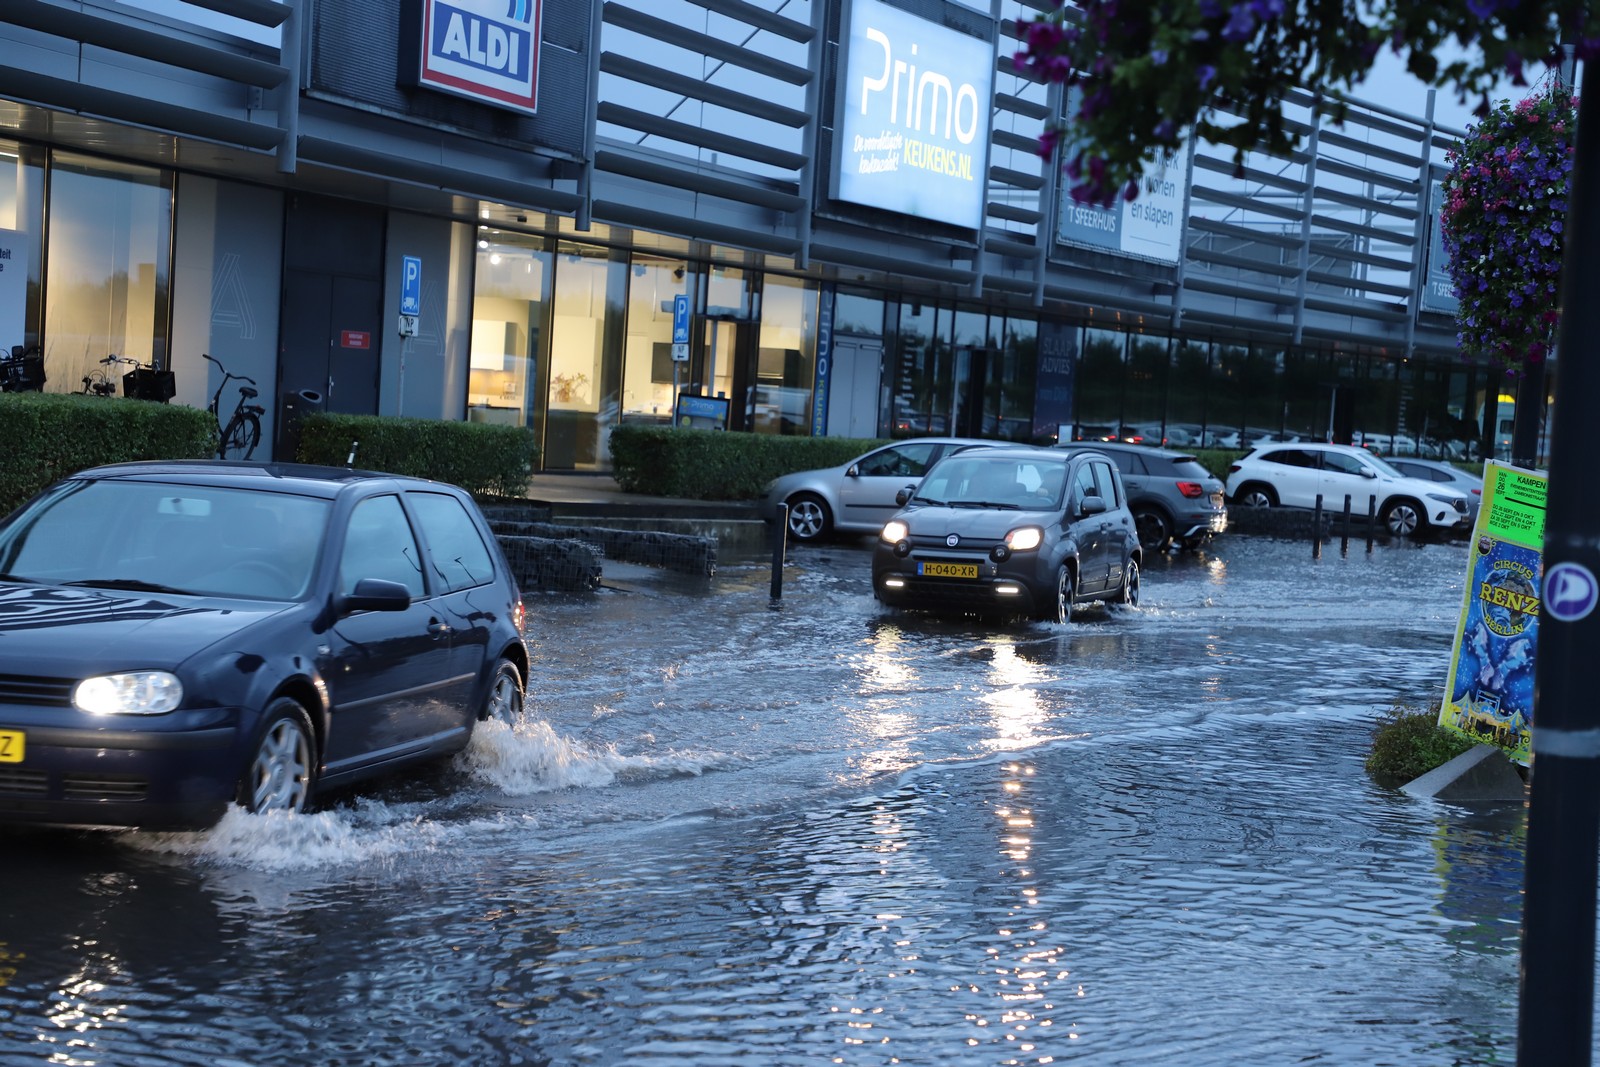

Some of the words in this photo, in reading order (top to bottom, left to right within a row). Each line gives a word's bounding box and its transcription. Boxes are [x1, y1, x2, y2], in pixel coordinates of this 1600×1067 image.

[441, 12, 519, 75] ALDI
[861, 27, 978, 145] Primo
[903, 138, 973, 181] KEUKENS.NL
[1075, 208, 1116, 233] SFEERHUIS
[1131, 202, 1142, 219] en
[1144, 201, 1174, 228] slapen
[406, 262, 417, 290] P
[677, 299, 686, 323] P
[1041, 358, 1071, 375] ADVIES
[1497, 482, 1505, 491] 26
[1517, 476, 1546, 489] KAMPEN
[925, 565, 975, 577] H-040-XR
[1493, 560, 1534, 580] CIRCUS
[1480, 582, 1540, 616] RENZ
[1484, 614, 1525, 635] BERLIN
